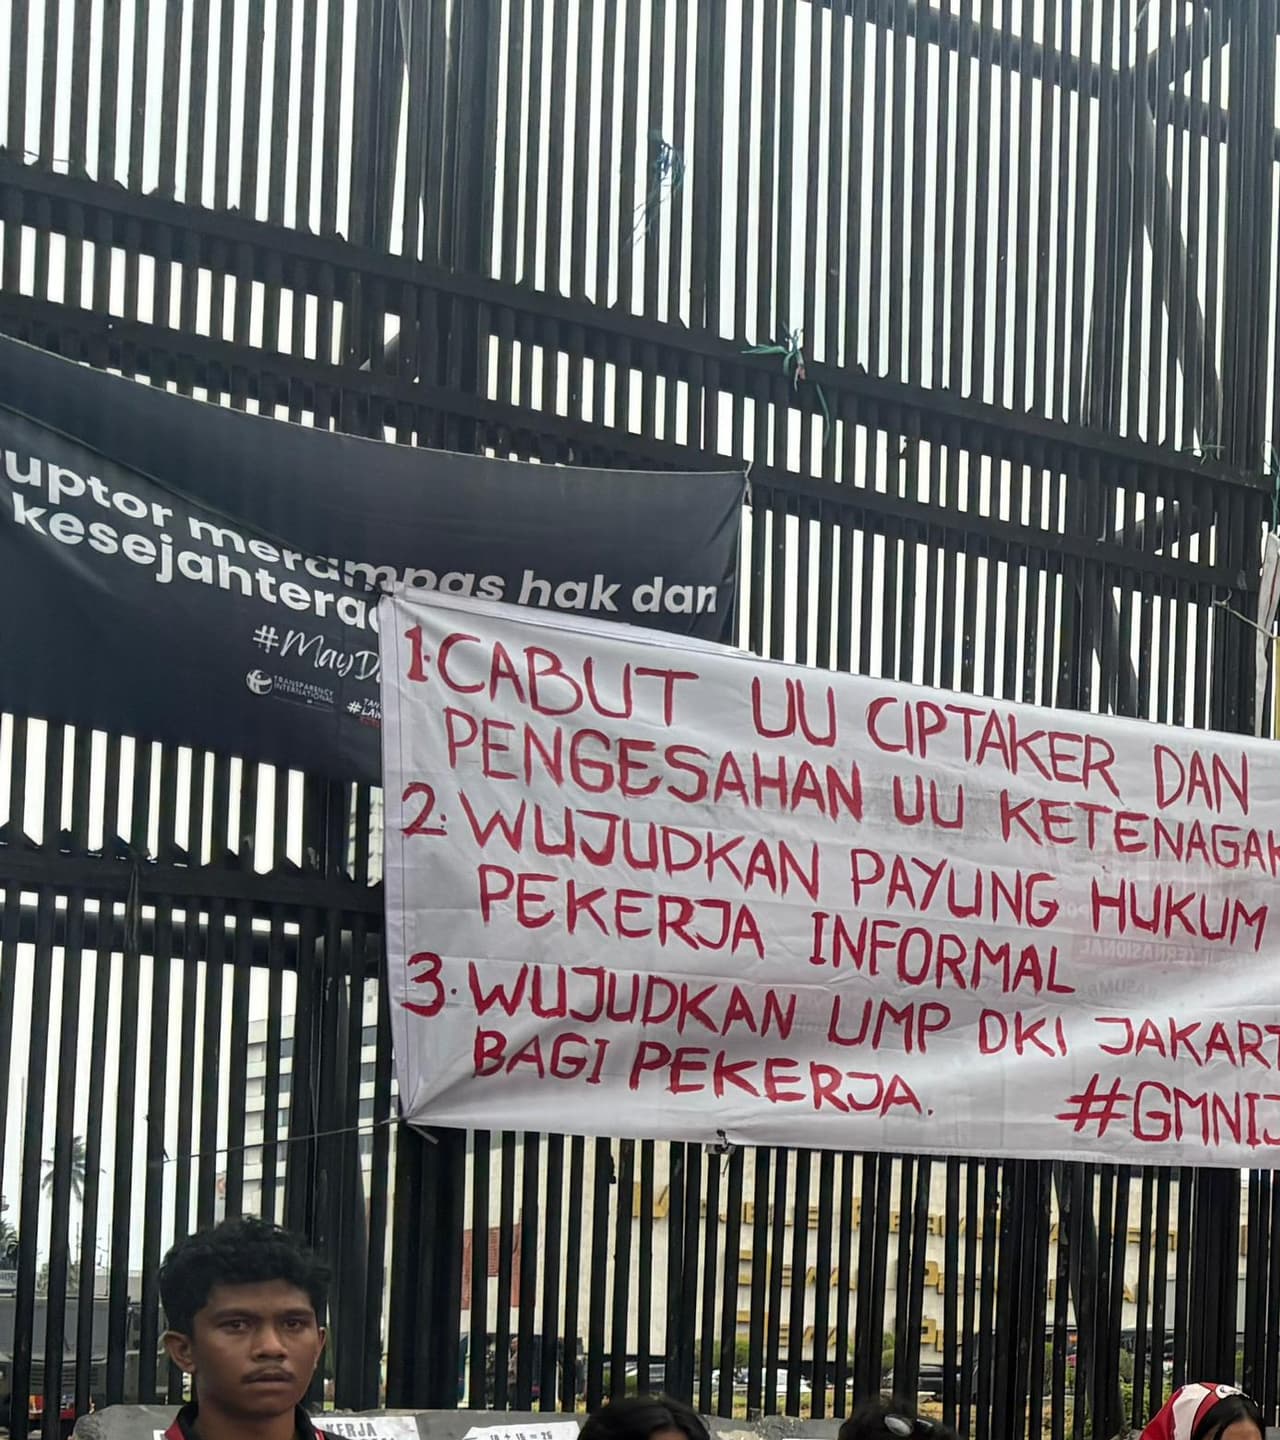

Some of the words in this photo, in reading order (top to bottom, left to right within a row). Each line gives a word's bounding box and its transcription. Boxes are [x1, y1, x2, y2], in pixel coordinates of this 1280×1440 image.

[187, 515, 504, 603] merampas
[517, 569, 619, 613] hak
[631, 576, 717, 614] dan
[444, 706, 864, 824] PENGESAHAN
[893, 774, 964, 830] UU
[751, 677, 837, 748] UU
[866, 696, 1124, 806] CIPTAKER
[1154, 743, 1249, 816] DAN
[458, 790, 821, 900] WUJUDKAN
[851, 847, 1060, 929] PAYUNG
[1091, 875, 1268, 953] HUKUM
[476, 864, 765, 960] PEKERJA
[810, 911, 1076, 996] INFORMAL
[468, 961, 797, 1040] WUJUDKAN
[827, 993, 951, 1055] UMP
[978, 1008, 1067, 1057] DKI
[472, 1025, 610, 1084] BAGI
[629, 1041, 934, 1117] PEKERJA.
